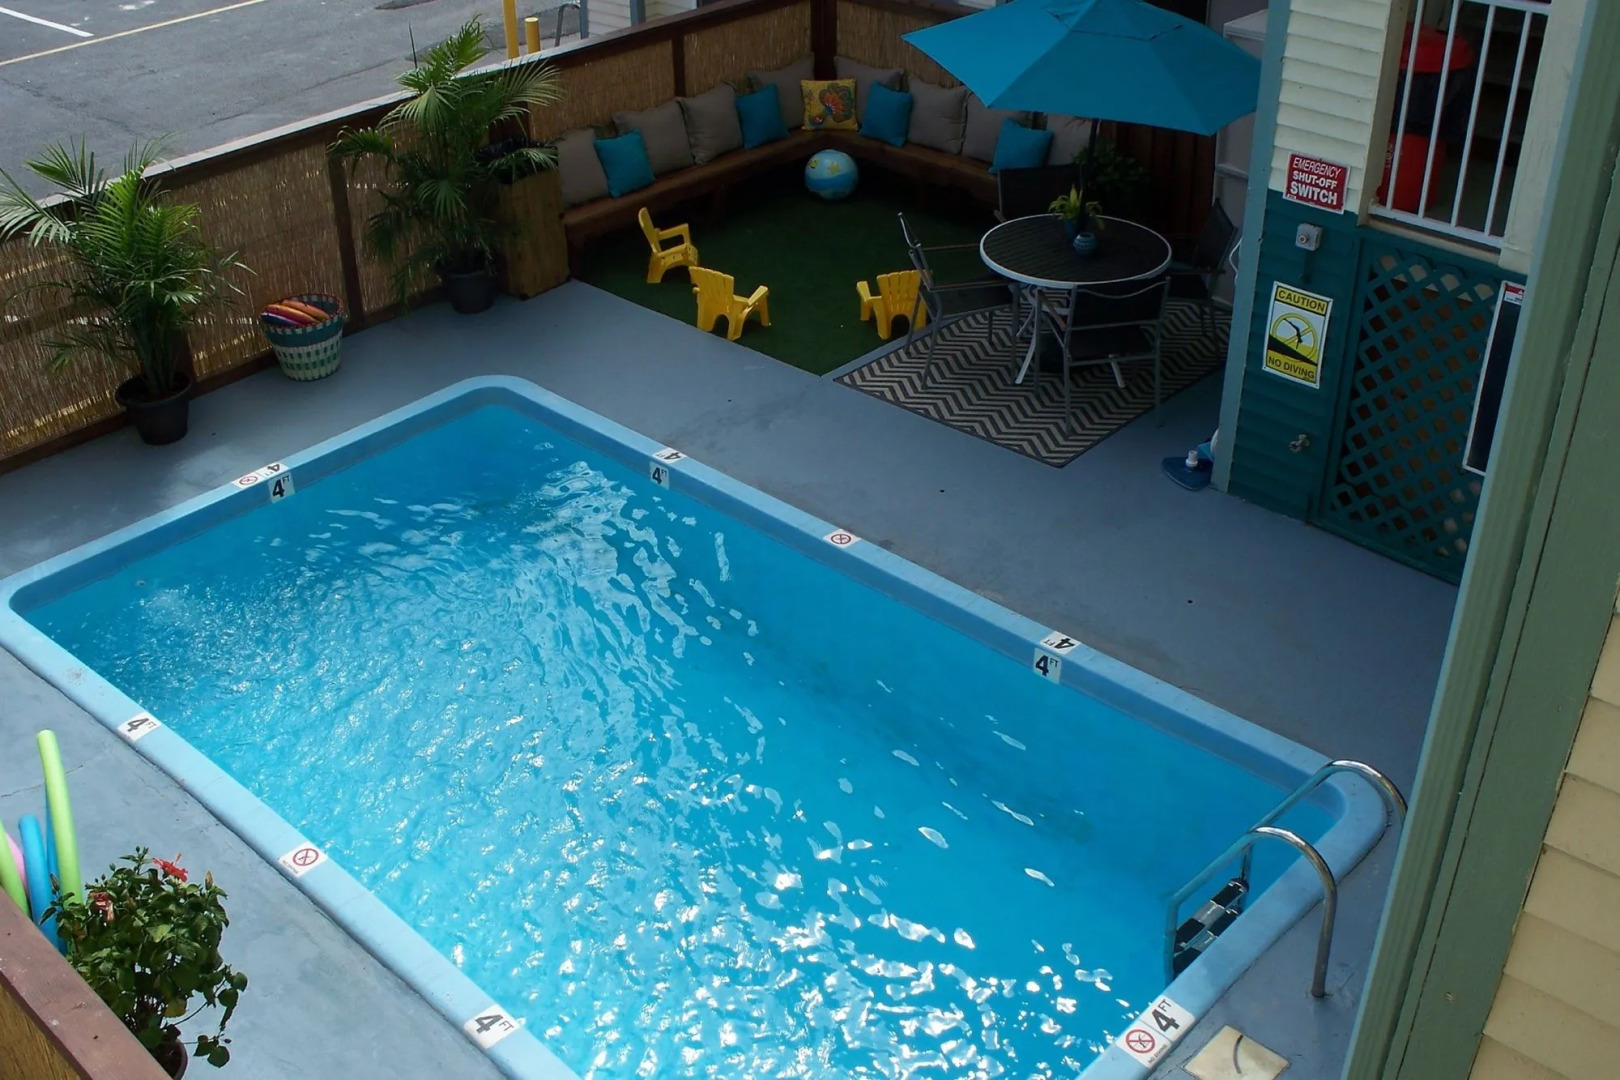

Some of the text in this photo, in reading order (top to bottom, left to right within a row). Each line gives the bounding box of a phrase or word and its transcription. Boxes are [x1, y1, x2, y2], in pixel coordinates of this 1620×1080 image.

[1293, 157, 1341, 178] EMERGENCY
[1293, 170, 1338, 190] SHUT-OFF
[1290, 181, 1338, 206] SWITCH
[1278, 290, 1326, 312] CAUTION
[1268, 356, 1315, 380] NO DIVING
[664, 452, 682, 460] 4
[267, 463, 281, 472] 4
[652, 467, 662, 485] 4
[272, 479, 285, 498] 4
[1054, 637, 1076, 650] 4
[1035, 655, 1060, 677] 4 FT
[127, 718, 150, 732] 4
[1157, 998, 1172, 1013] FT
[475, 1014, 515, 1034] 4 FT
[1152, 1009, 1181, 1032] 4
